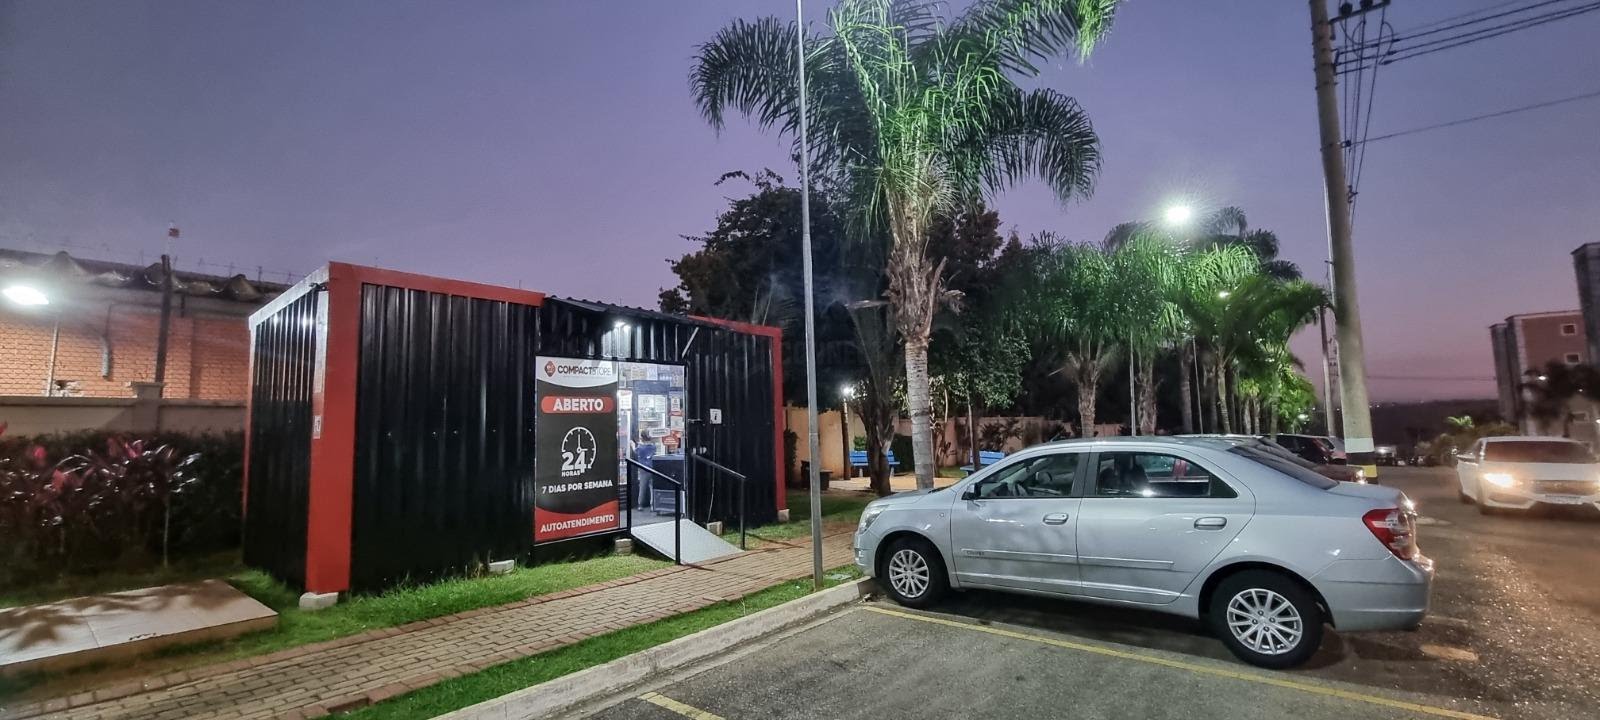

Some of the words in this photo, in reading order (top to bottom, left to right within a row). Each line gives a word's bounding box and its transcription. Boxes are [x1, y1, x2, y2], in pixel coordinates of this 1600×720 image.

[553, 398, 604, 411] ABERTO
[561, 451, 587, 473] 24
[542, 486, 547, 494] 7
[548, 484, 566, 493] DIAS
[568, 483, 583, 491] POR
[584, 480, 613, 490] SEMANA
[540, 514, 615, 533] AUTOATENDIMENTO
